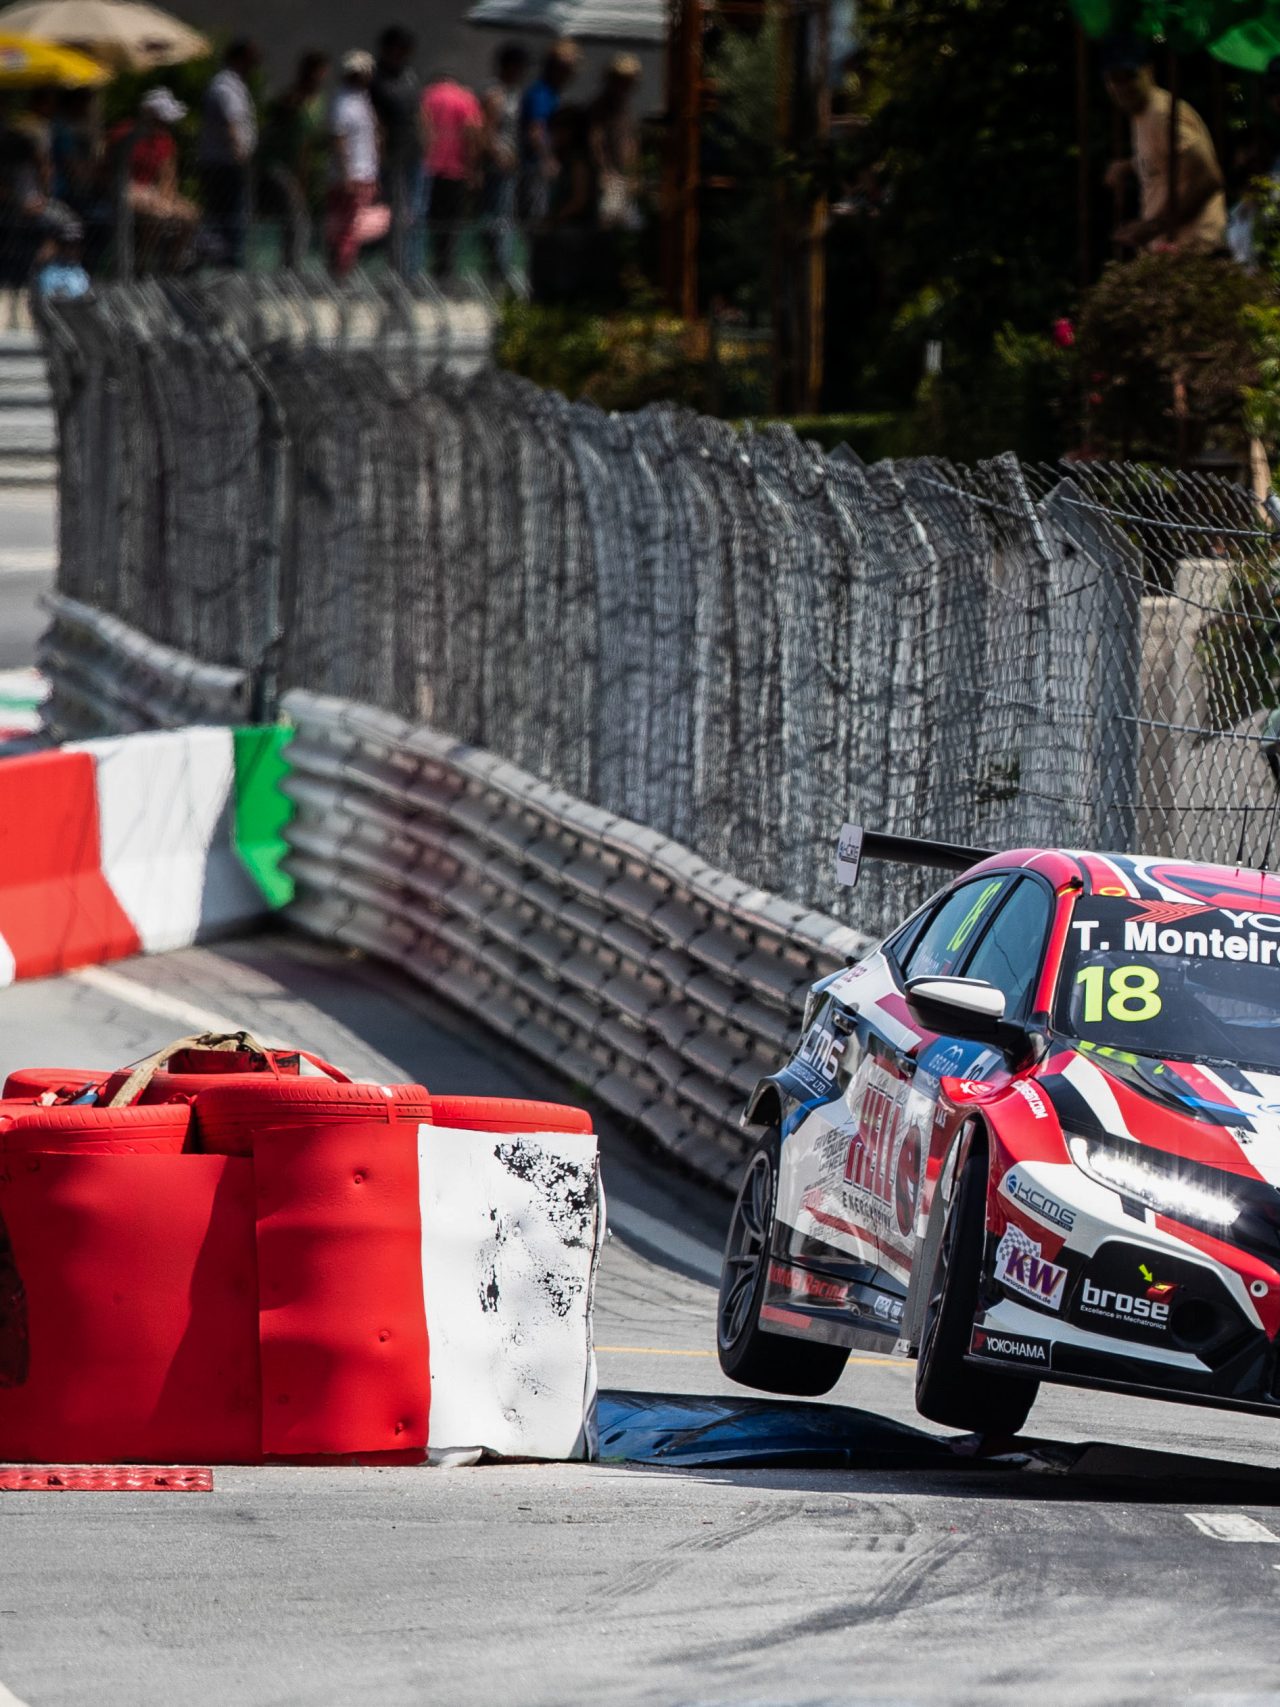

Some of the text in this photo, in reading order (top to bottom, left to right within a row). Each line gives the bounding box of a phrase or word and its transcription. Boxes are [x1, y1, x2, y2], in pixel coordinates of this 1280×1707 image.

[1071, 920, 1110, 951] T.
[1076, 965, 1163, 1023] 18
[799, 1022, 845, 1081] CMG
[1016, 1182, 1077, 1225] KCMG
[1005, 1247, 1065, 1295] KW
[1080, 1304, 1167, 1330] Excellence in Mechatronics
[1082, 1278, 1169, 1321] brose
[986, 1336, 1046, 1359] YOKOHAMA
